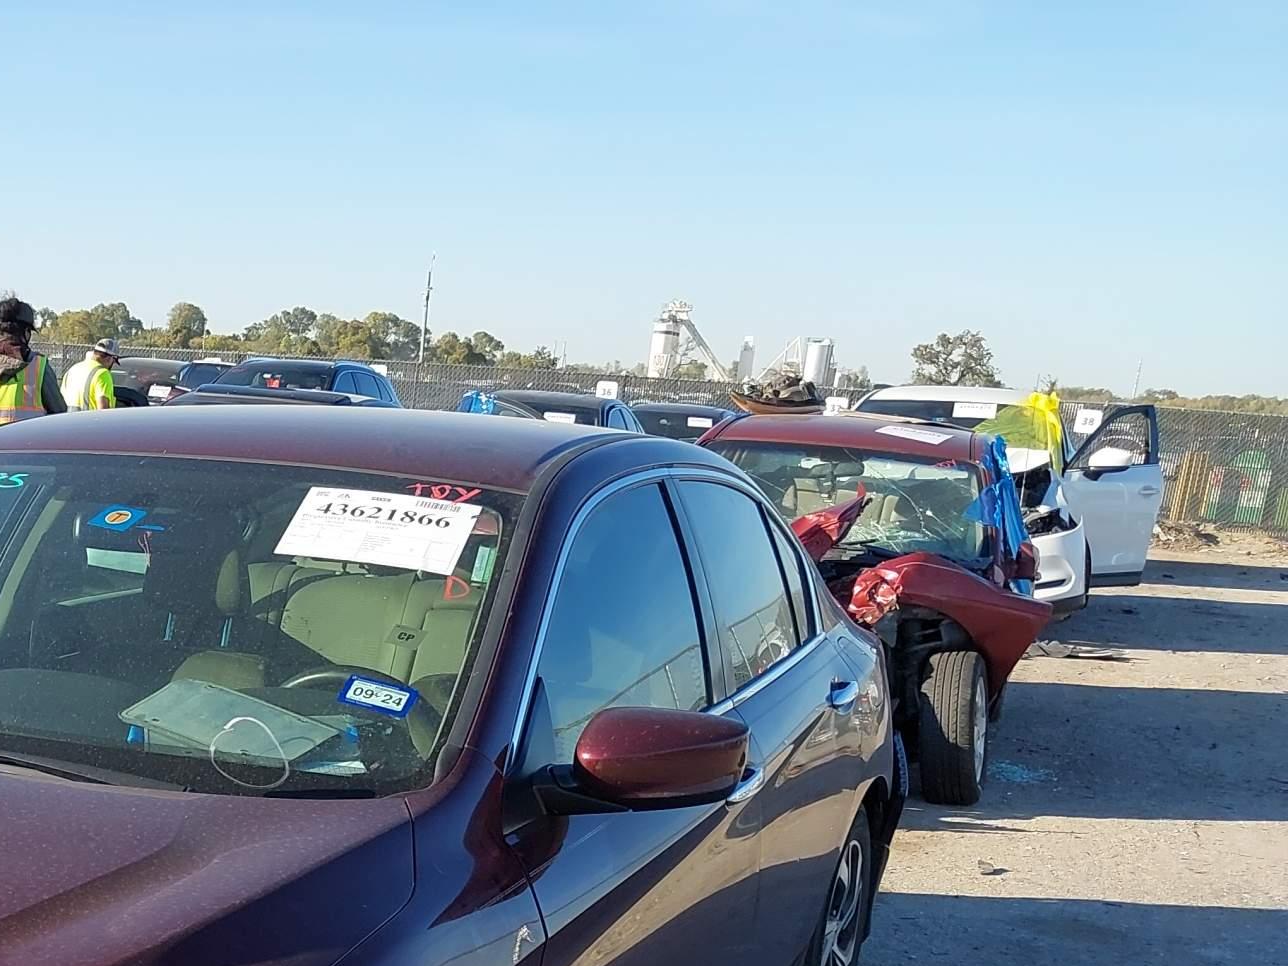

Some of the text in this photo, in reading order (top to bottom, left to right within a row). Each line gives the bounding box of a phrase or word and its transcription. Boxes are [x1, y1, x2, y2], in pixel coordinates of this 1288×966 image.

[1081, 417, 1095, 426] 38
[315, 502, 453, 529] 43621866
[443, 575, 470, 601] D
[397, 631, 416, 642] CP
